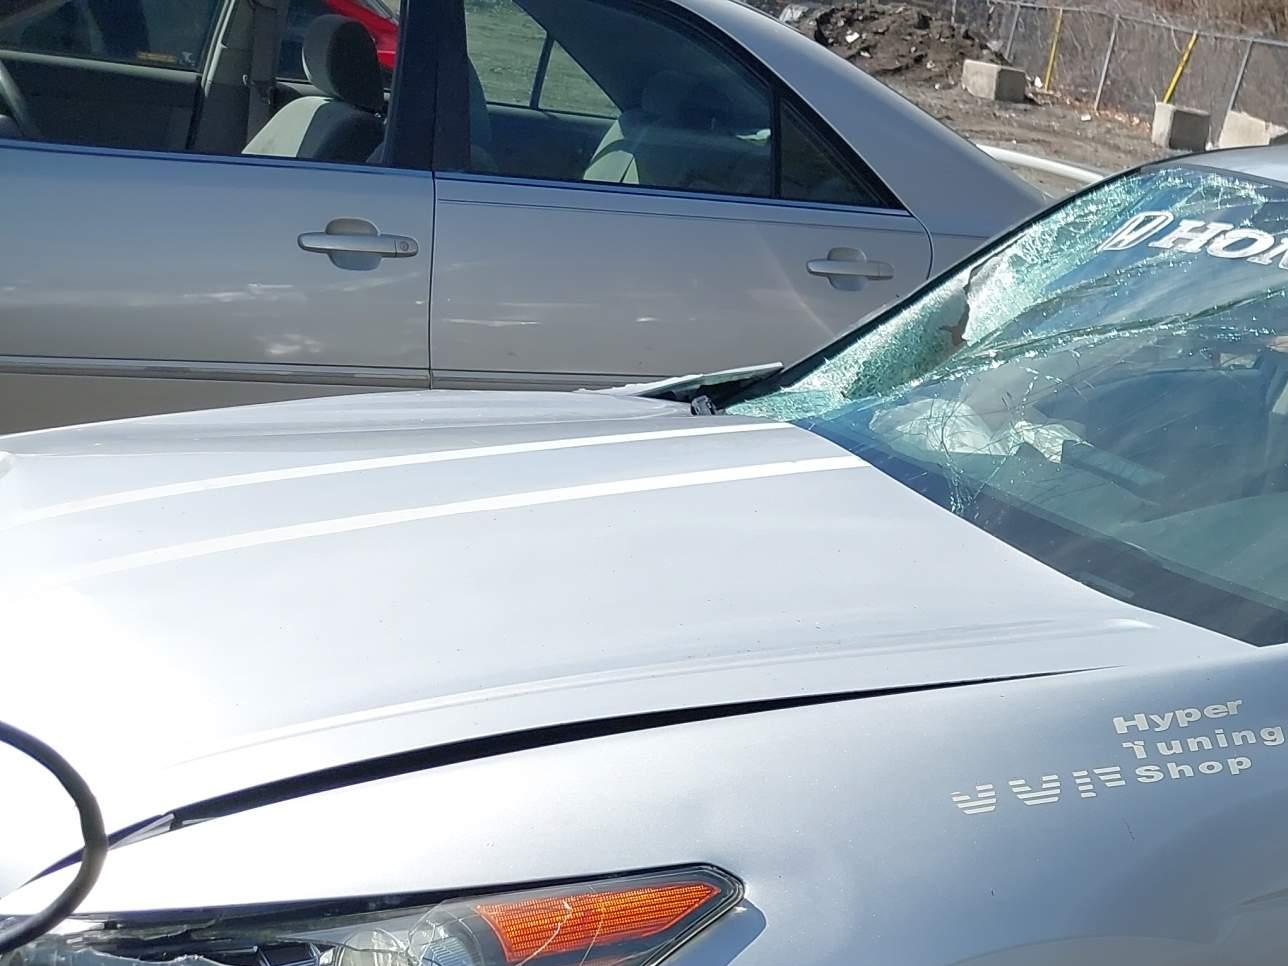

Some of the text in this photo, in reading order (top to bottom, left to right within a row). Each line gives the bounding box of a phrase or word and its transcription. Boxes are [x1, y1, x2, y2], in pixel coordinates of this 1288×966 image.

[1112, 700, 1242, 735] Hyper
[1123, 725, 1286, 760] Tuning
[1135, 756, 1252, 784] Shop
